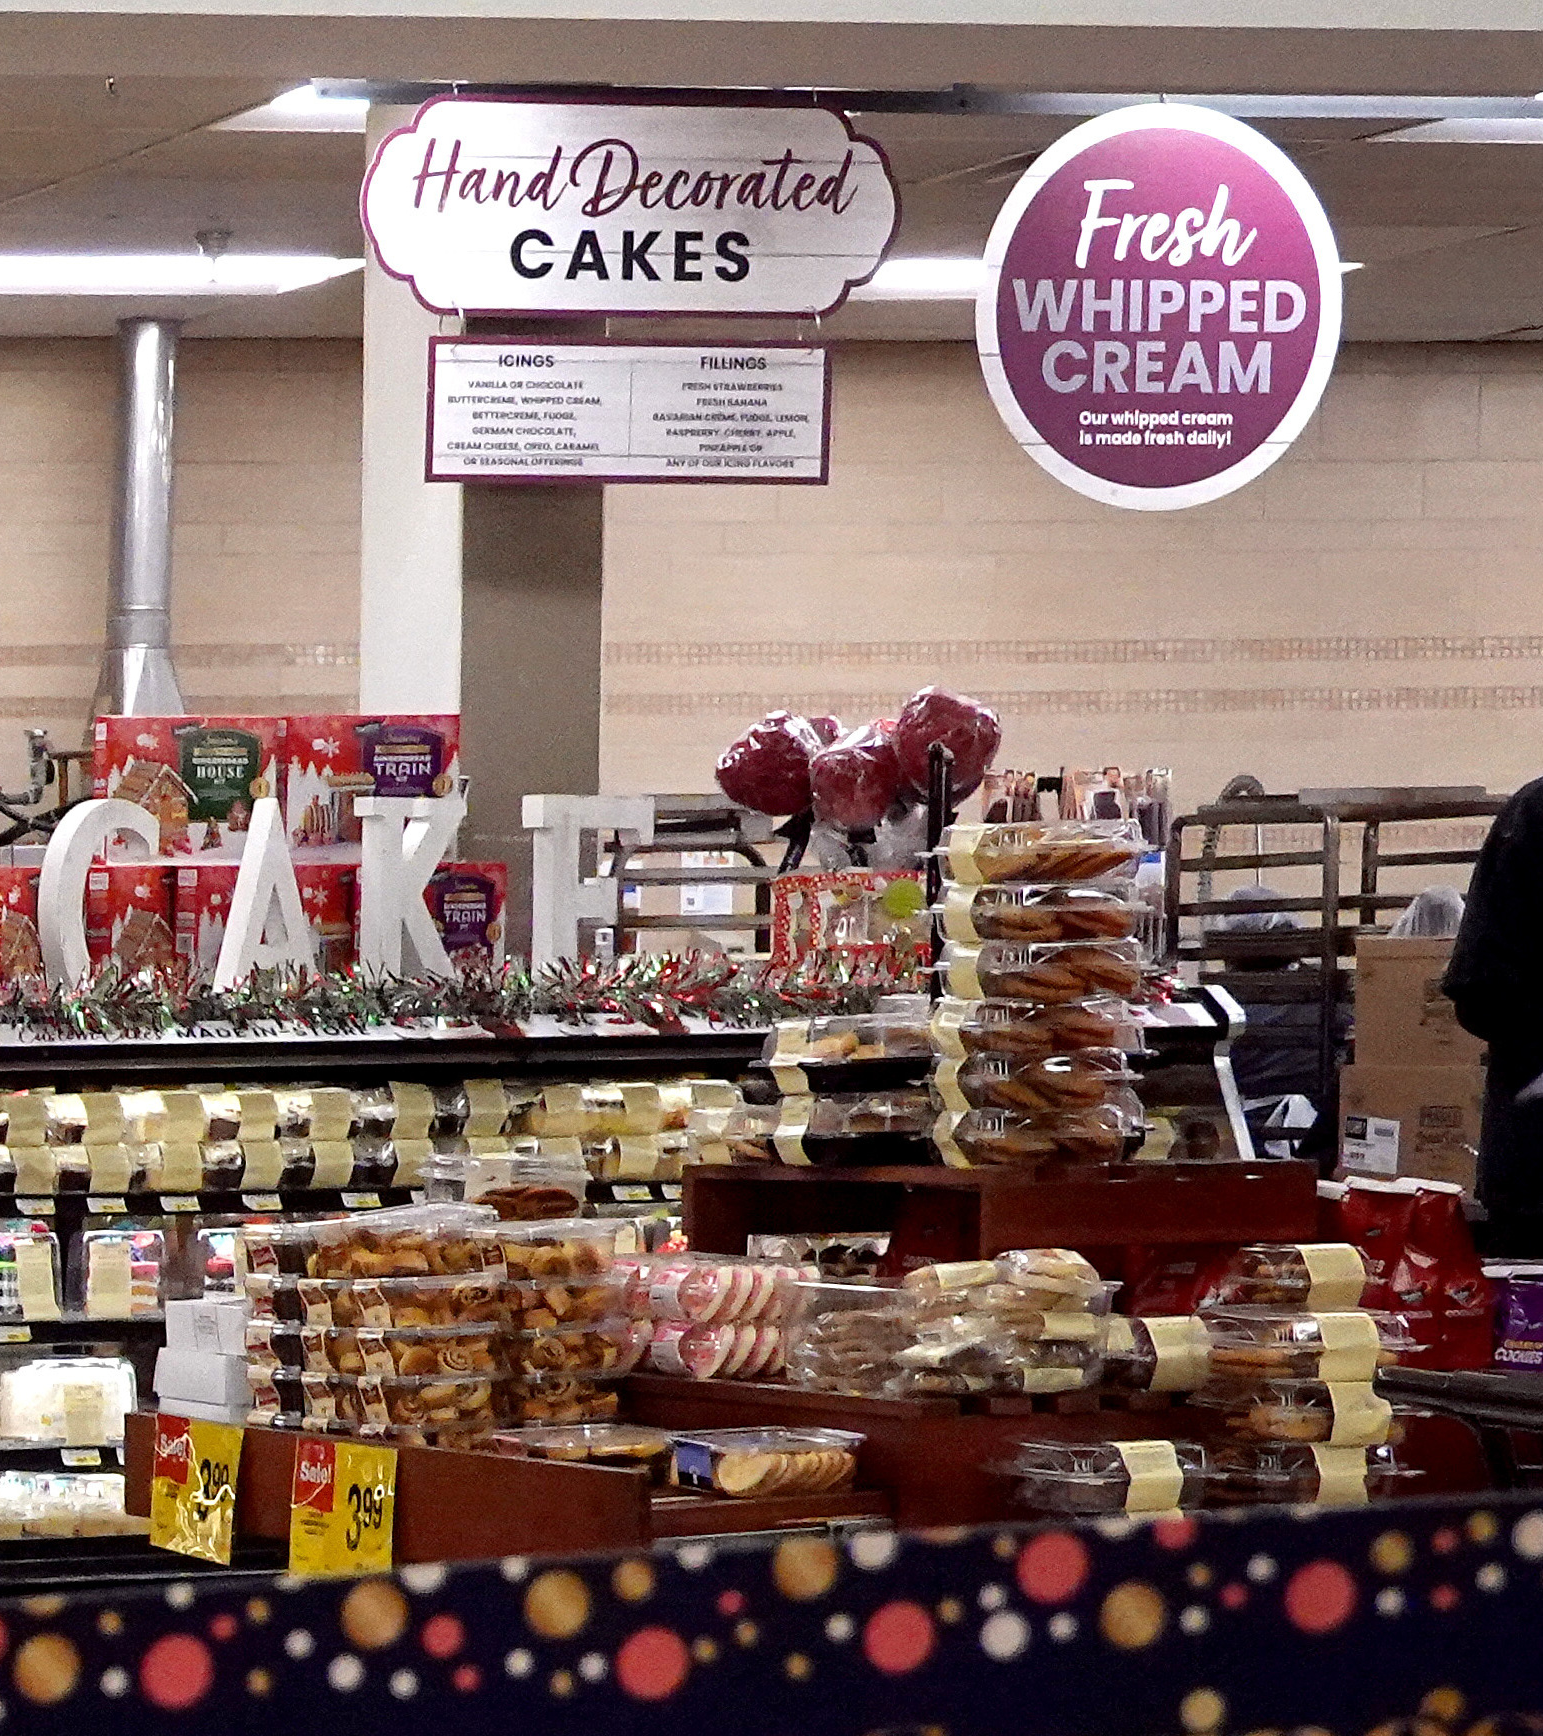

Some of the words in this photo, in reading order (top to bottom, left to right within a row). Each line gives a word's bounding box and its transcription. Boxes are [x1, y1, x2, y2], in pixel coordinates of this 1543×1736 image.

[412, 137, 569, 214] Hand
[570, 137, 859, 218] Decorated
[1074, 178, 1258, 269] Fresh
[509, 228, 752, 282] CAKES
[1011, 278, 1307, 333] WHIPPED
[498, 354, 555, 368] ICINGS
[700, 356, 768, 370] FILLINGS
[1041, 339, 1273, 395] CREAM
[1079, 410, 1110, 426] Our
[1111, 409, 1179, 428] whipped
[1181, 413, 1233, 426] cream
[1089, 431, 1141, 446] made
[1144, 430, 1184, 445] fresh
[195, 764, 245, 779] HOUSE
[374, 762, 432, 776] TRAIN
[444, 908, 487, 925] TRAIN
